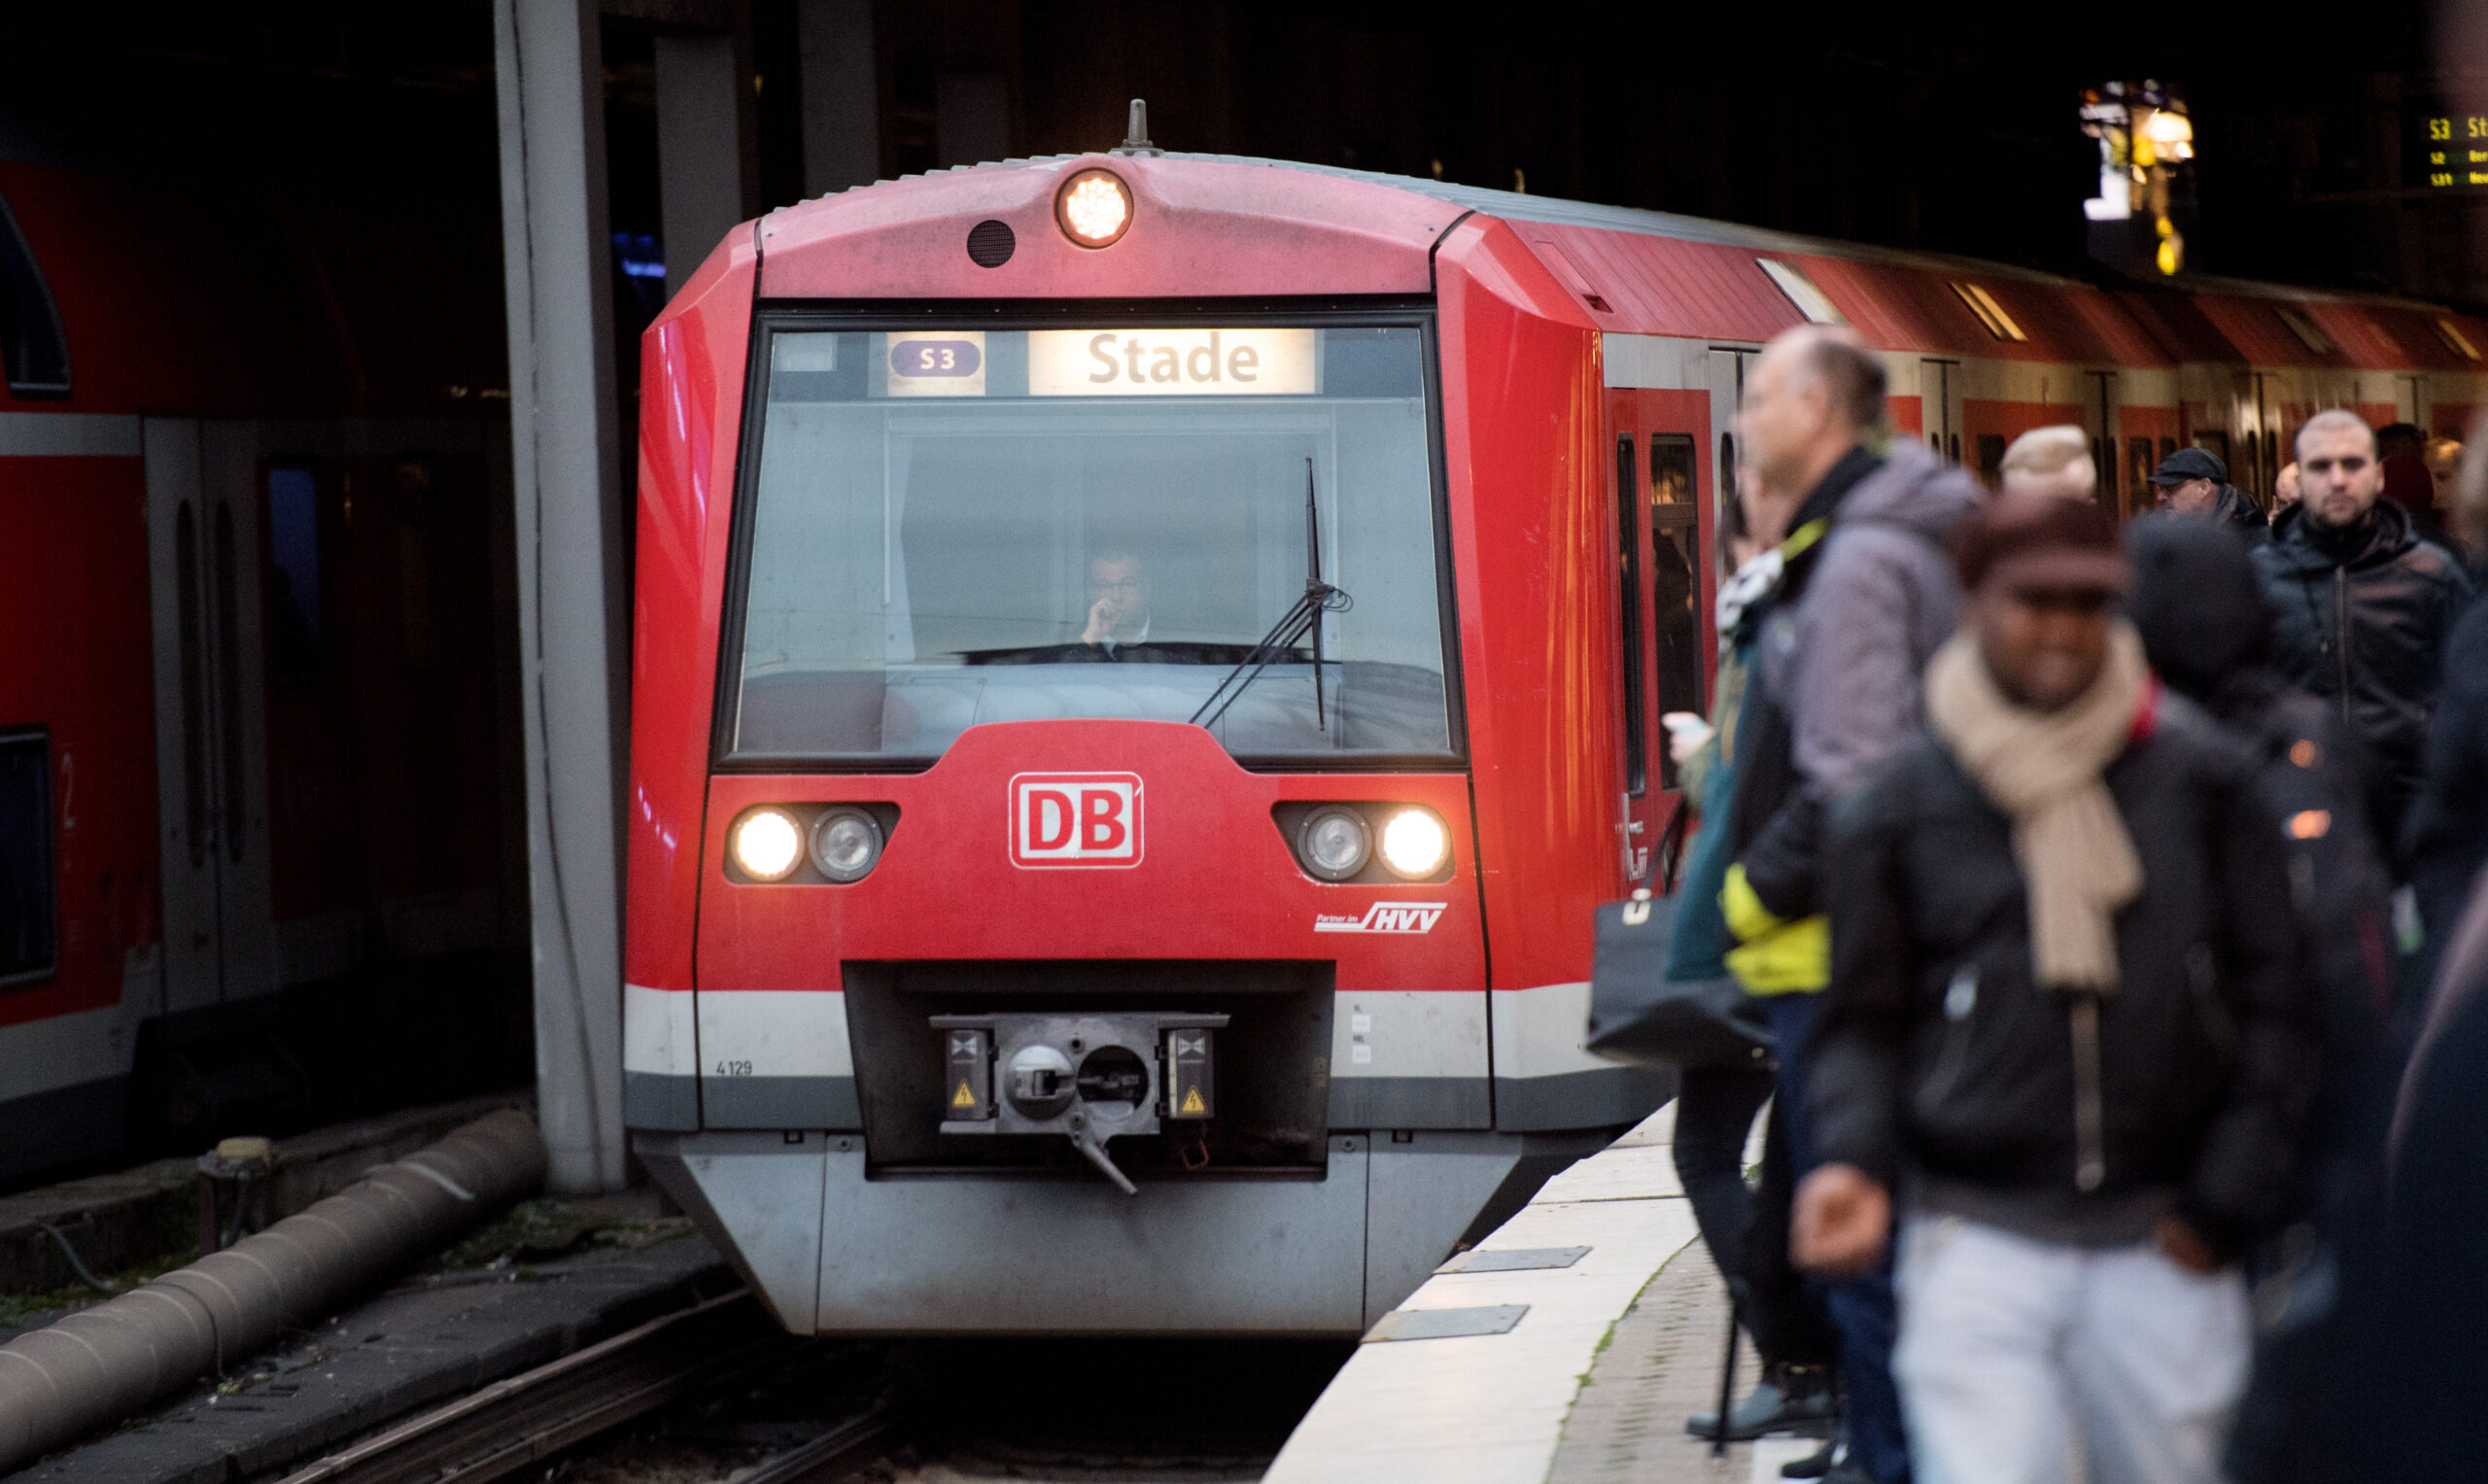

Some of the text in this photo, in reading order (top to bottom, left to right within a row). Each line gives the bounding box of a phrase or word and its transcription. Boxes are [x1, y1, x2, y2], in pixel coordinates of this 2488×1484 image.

[2430, 119, 2450, 140] S3
[1088, 331, 1260, 383] Stade
[1028, 789, 1126, 850] DB
[1317, 909, 1443, 930] Partner im HVV
